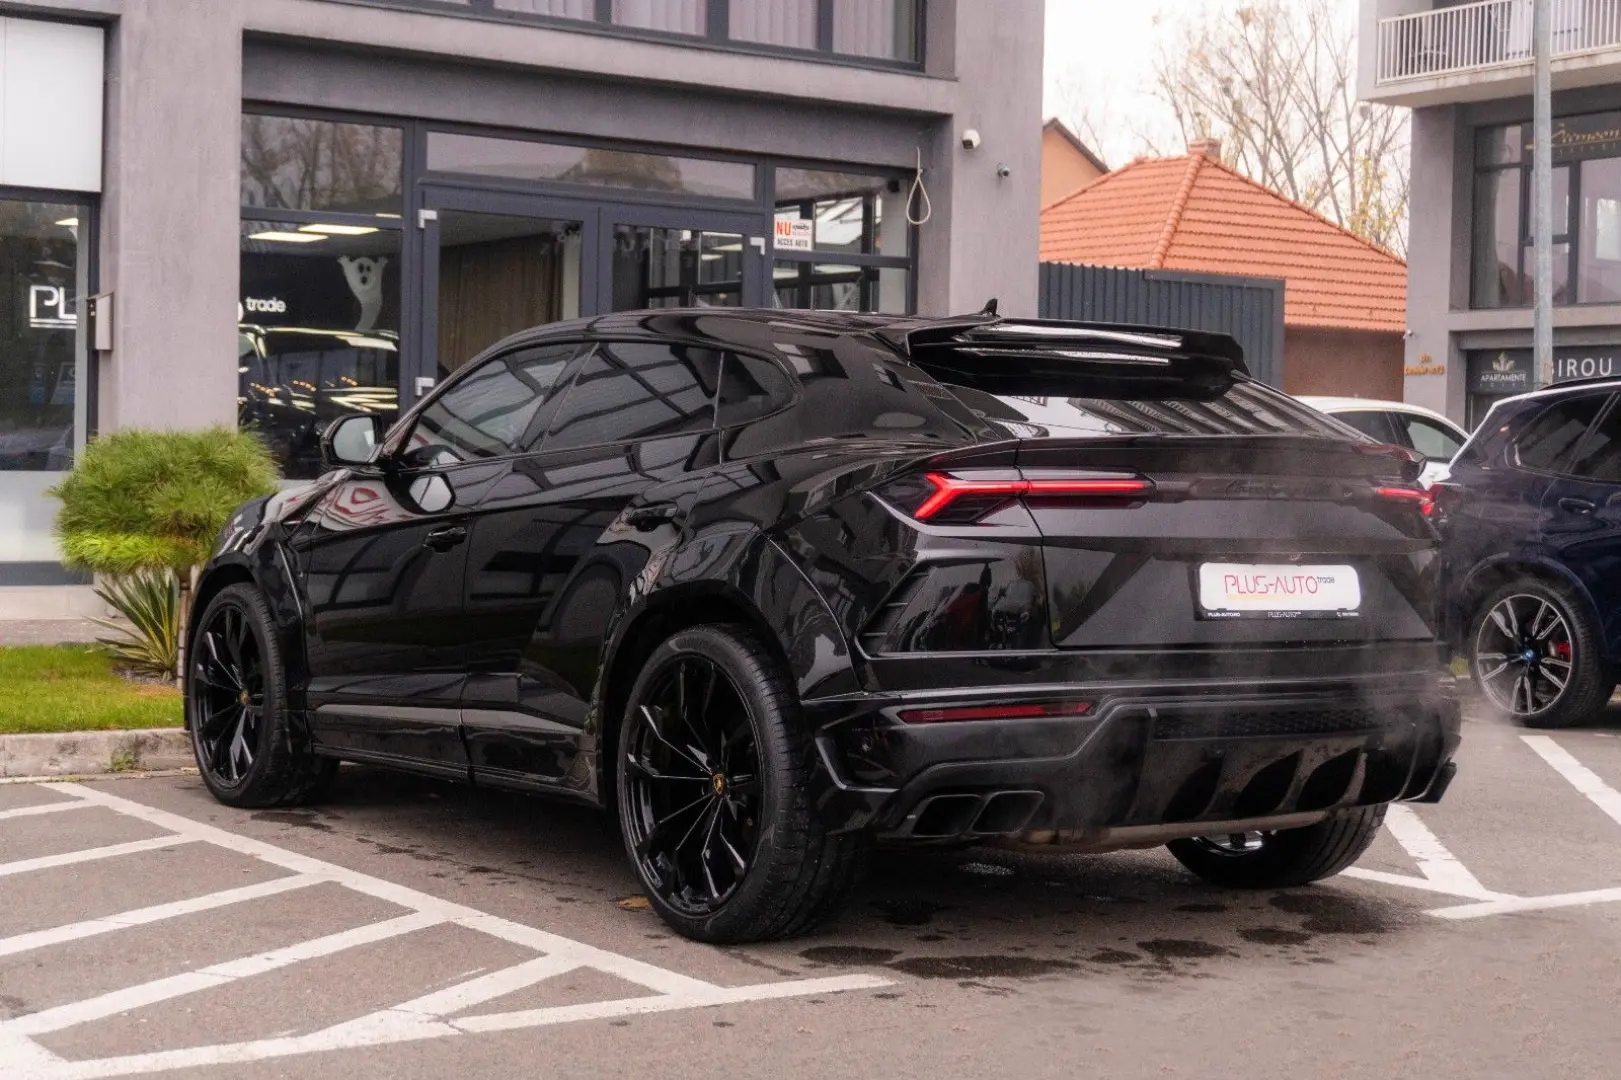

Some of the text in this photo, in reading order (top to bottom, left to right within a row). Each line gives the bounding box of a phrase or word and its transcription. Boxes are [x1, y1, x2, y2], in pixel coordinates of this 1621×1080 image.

[776, 221, 791, 236] NU
[246, 296, 286, 312] trade
[1552, 357, 1612, 377] IROU
[1480, 373, 1527, 382] APARTAMENTE
